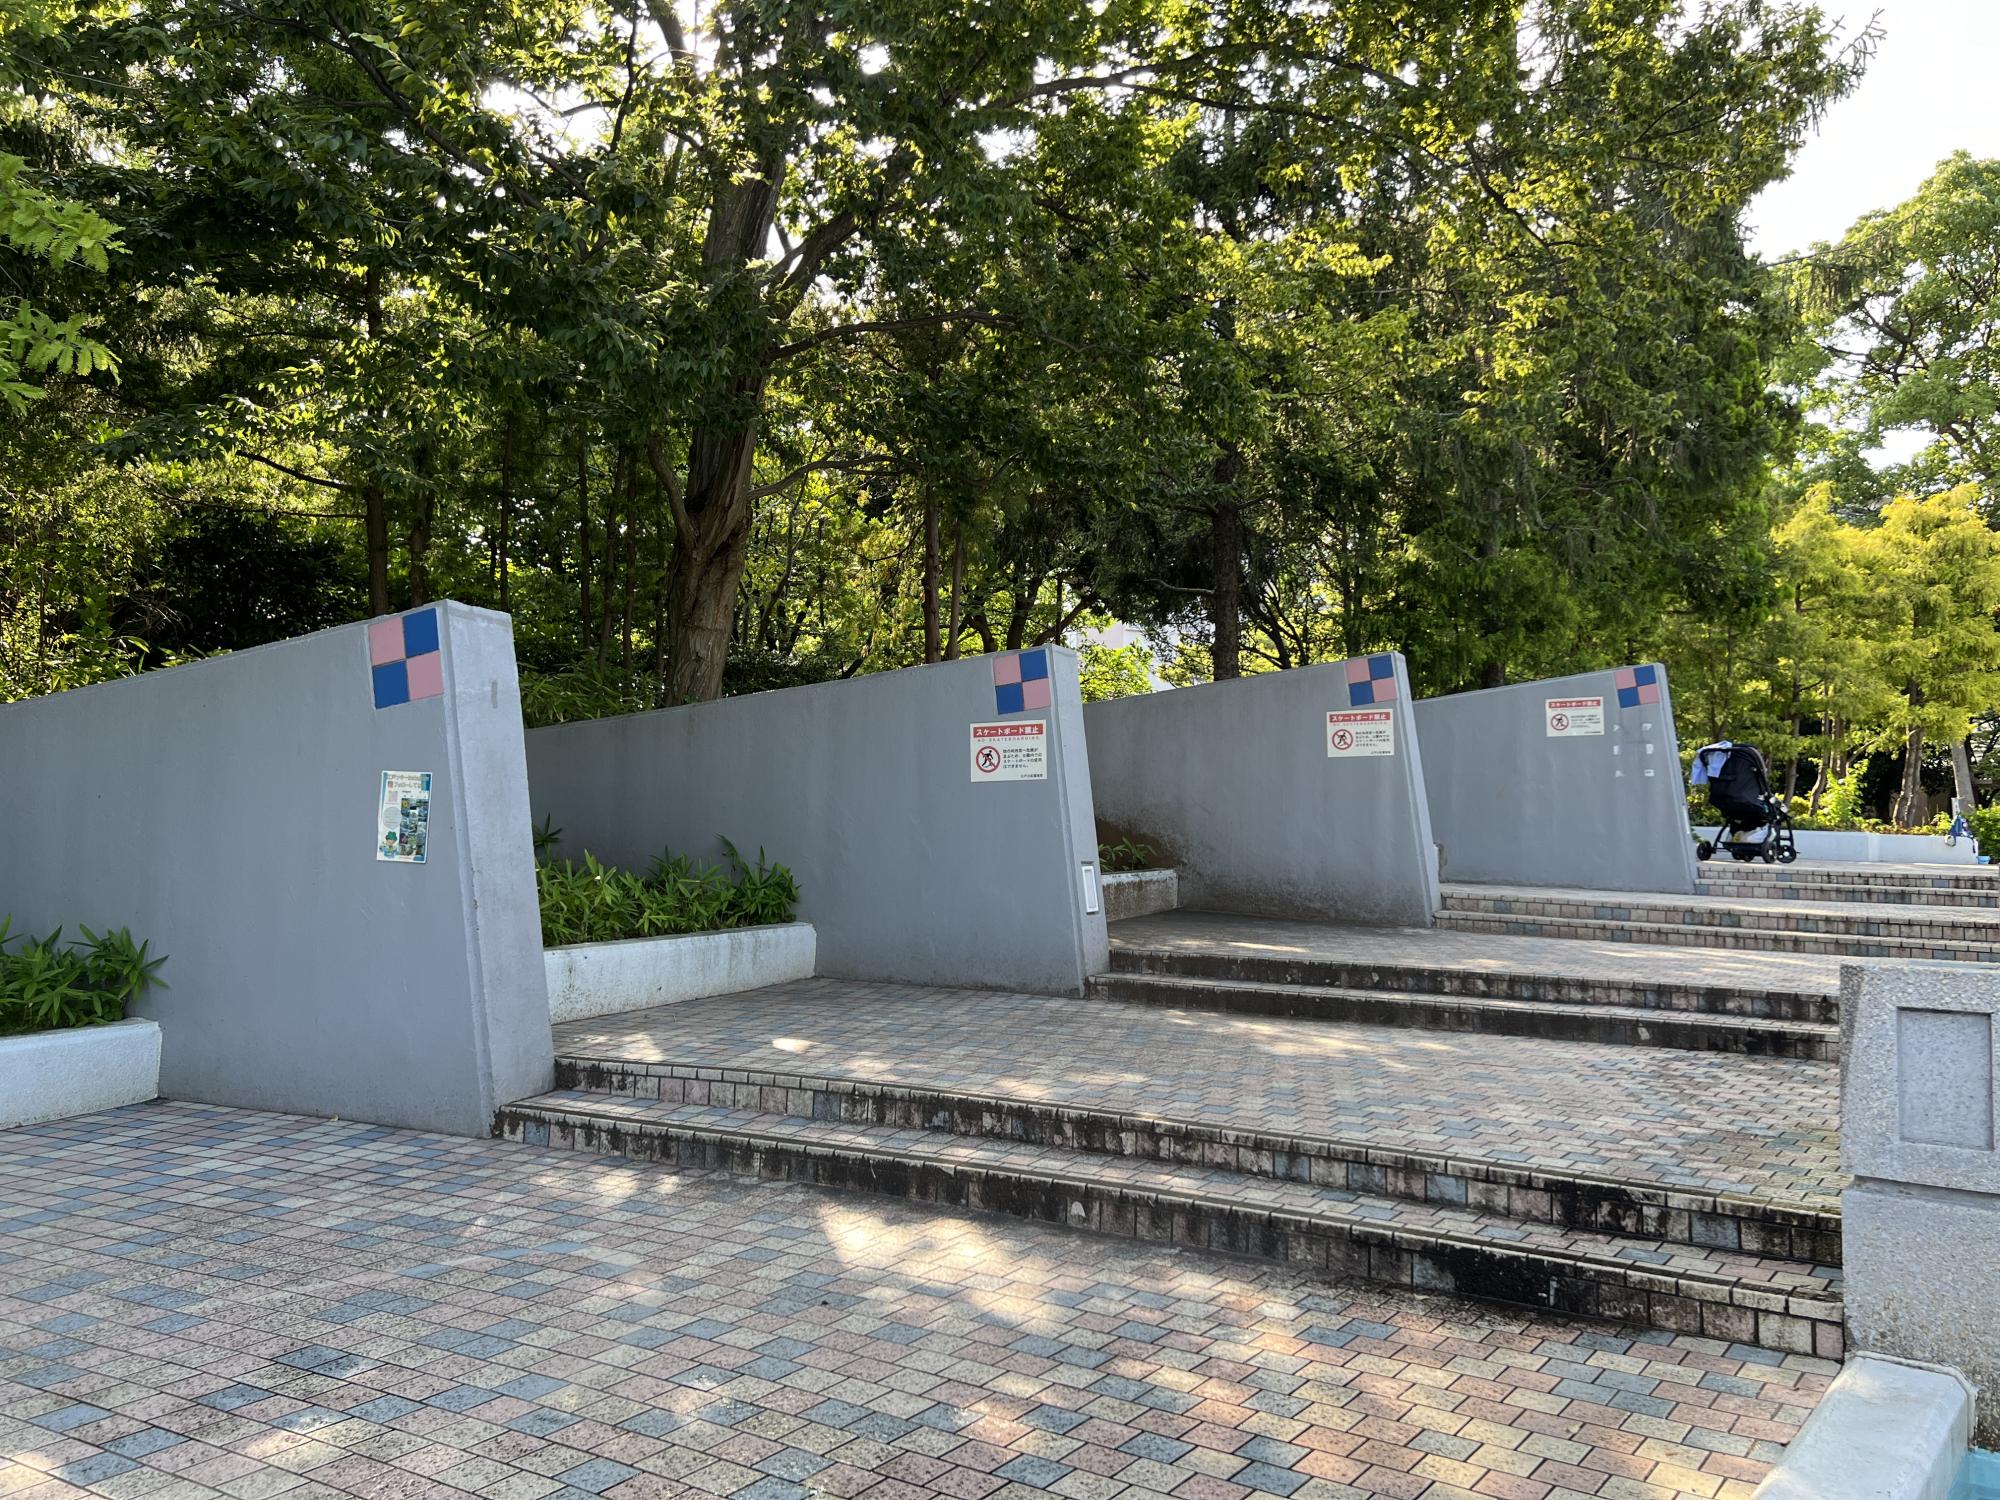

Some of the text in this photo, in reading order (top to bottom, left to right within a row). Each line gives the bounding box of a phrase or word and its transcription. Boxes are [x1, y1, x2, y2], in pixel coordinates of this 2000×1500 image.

[976, 726, 1039, 736] スケートボード禁止
